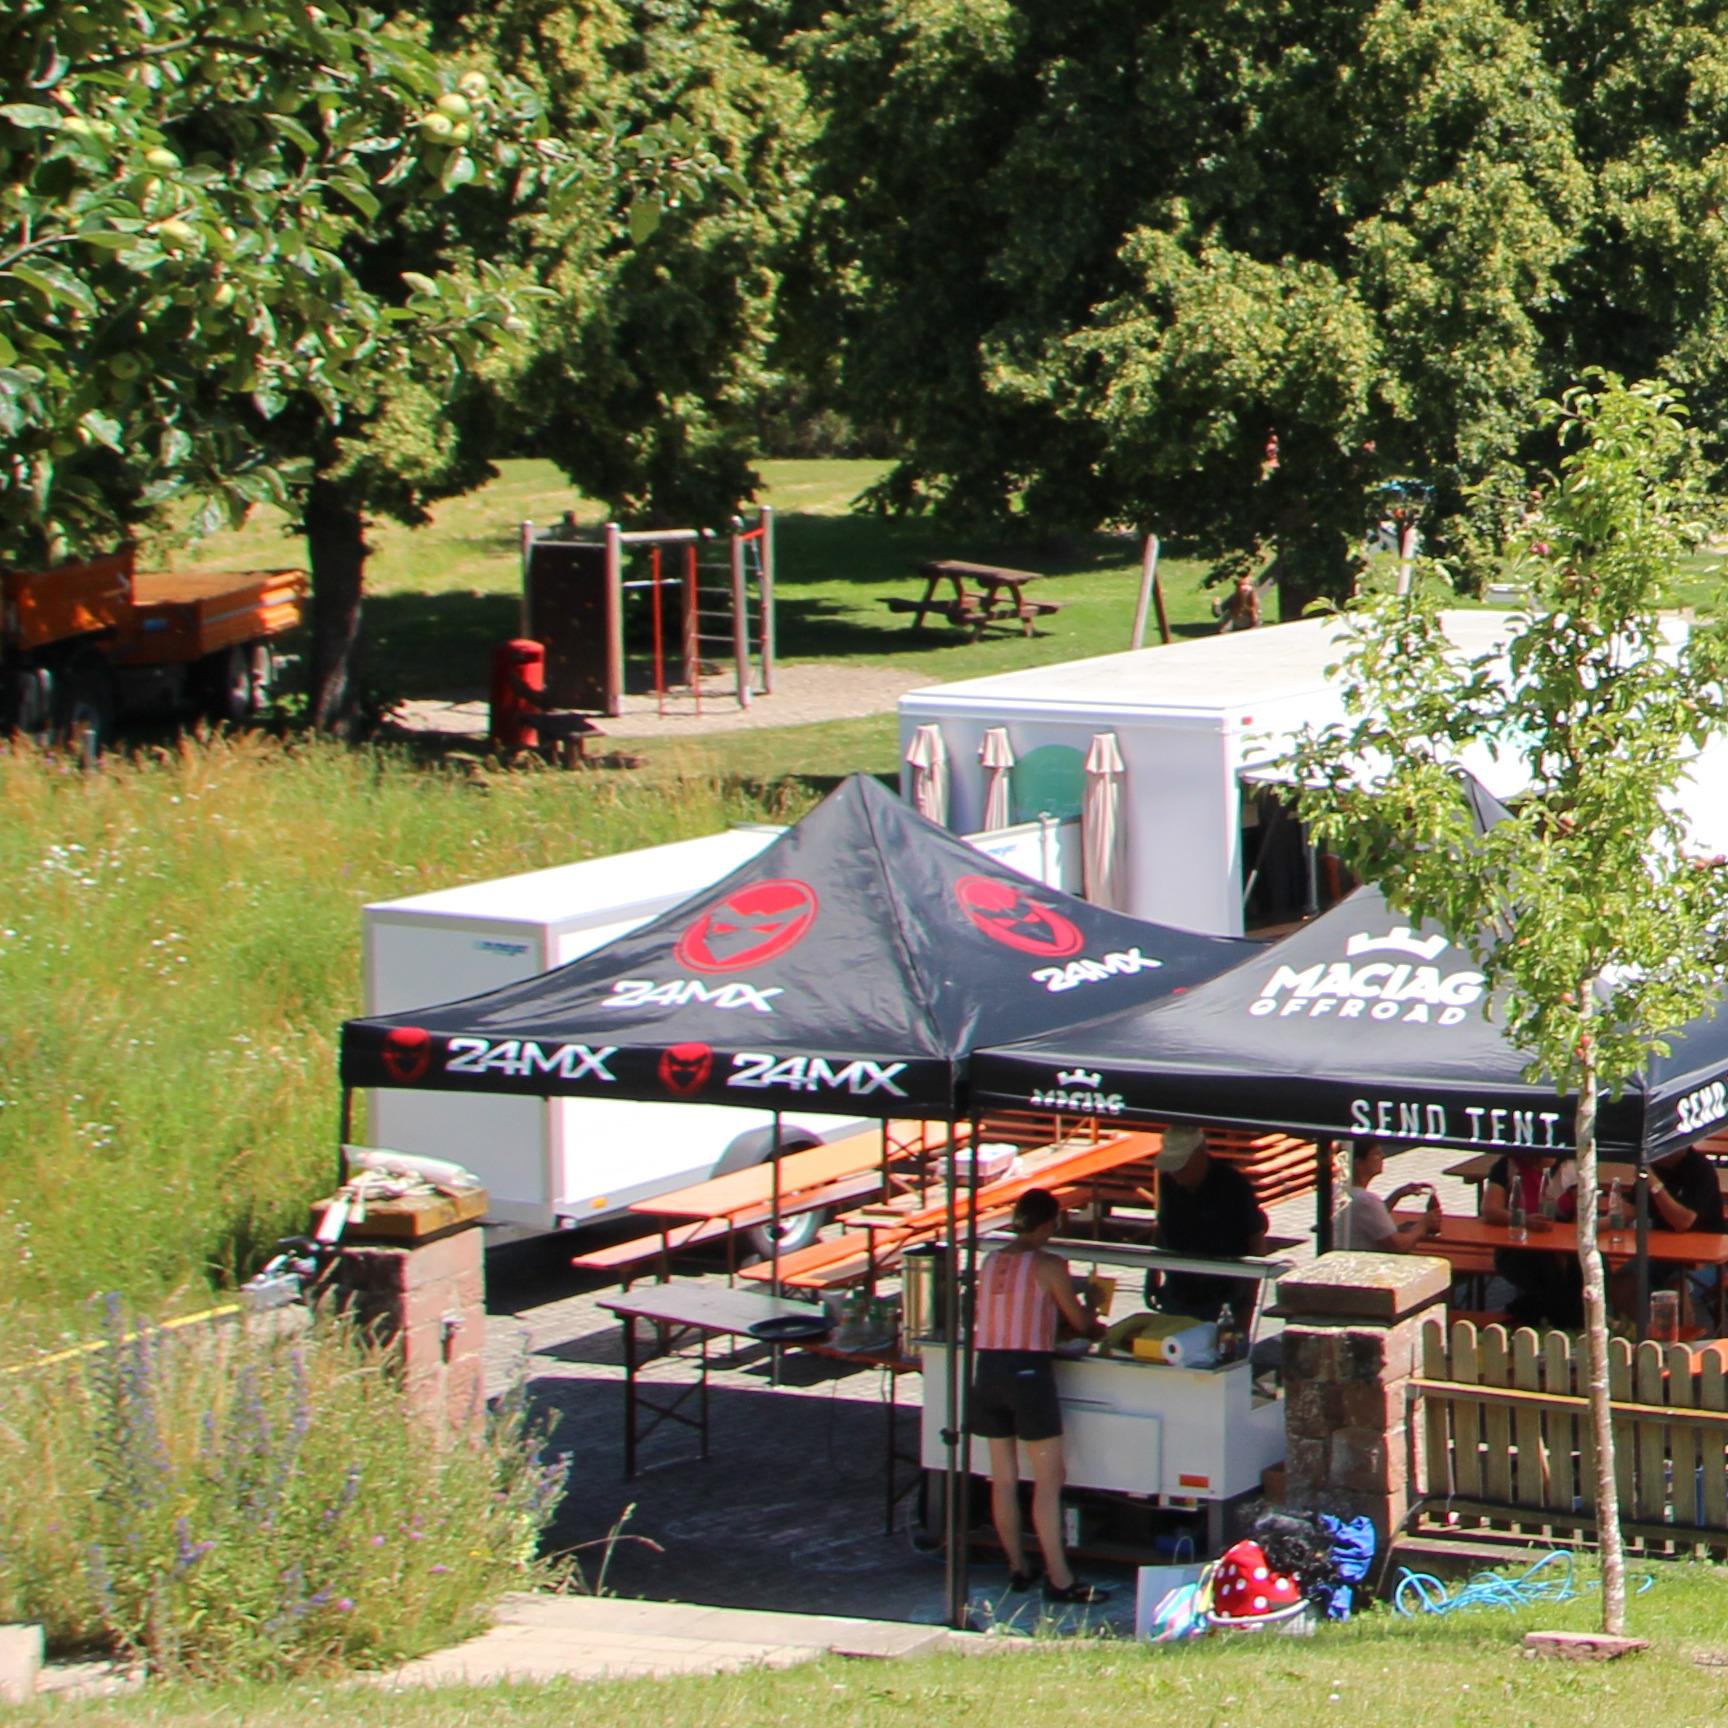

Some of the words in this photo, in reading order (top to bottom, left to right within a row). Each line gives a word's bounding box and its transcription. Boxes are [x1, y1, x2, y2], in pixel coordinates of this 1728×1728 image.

[1030, 947, 1164, 993] 24MX
[1259, 962, 1488, 1006] MACIAG
[600, 979, 785, 1013] 24MX
[1248, 998, 1467, 1026] OFFROAD
[445, 1037, 620, 1082] 24MX
[726, 1052, 909, 1098] 24MX
[1349, 1099, 1447, 1141] SEND
[1676, 1080, 1728, 1134] SEND
